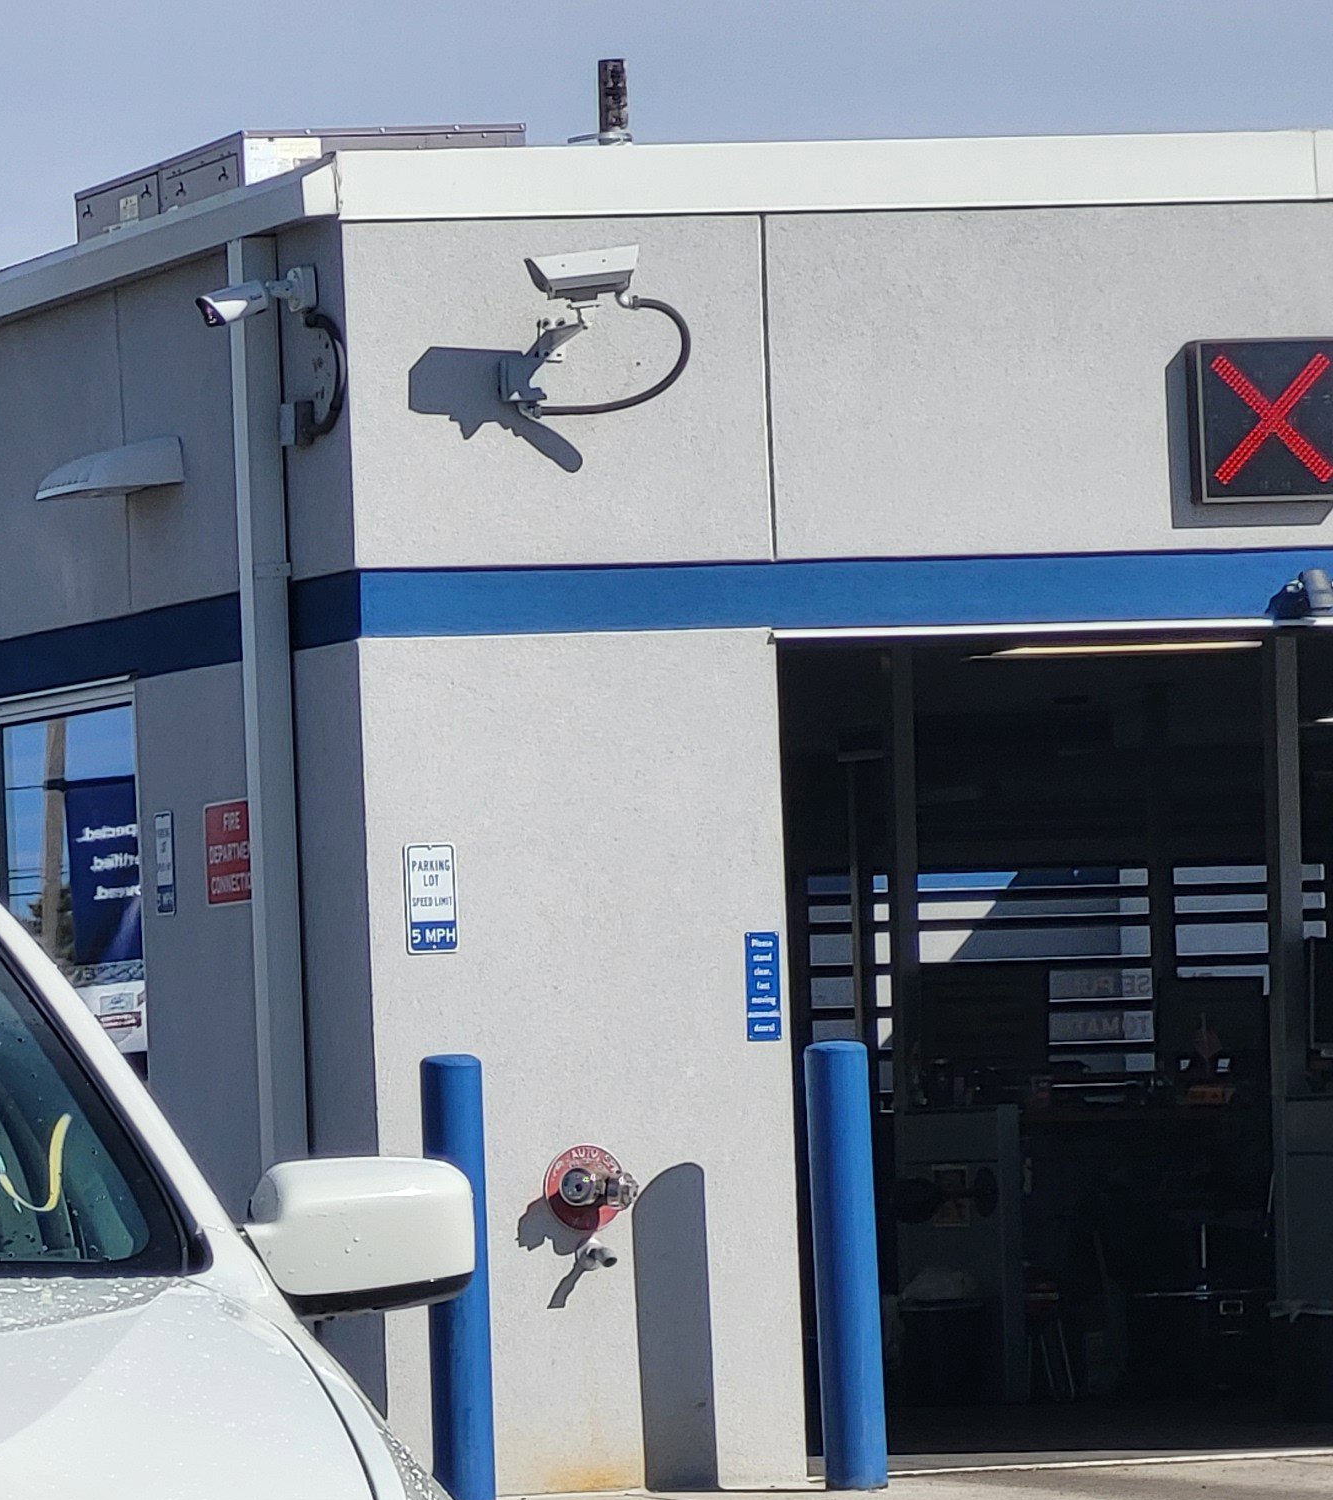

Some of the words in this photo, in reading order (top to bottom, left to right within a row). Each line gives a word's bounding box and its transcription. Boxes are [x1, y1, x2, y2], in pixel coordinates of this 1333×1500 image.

[223, 811, 240, 831] FIRE
[411, 859, 451, 872] PARKING
[423, 874, 439, 887] LOT
[412, 896, 433, 907] SPEED
[434, 896, 452, 906] LIMIT
[412, 928, 422, 944] 5
[425, 927, 456, 943] MPH
[751, 938, 773, 947] Please
[753, 953, 772, 962] stand
[756, 981, 771, 990] fast
[751, 995, 777, 1006] moving
